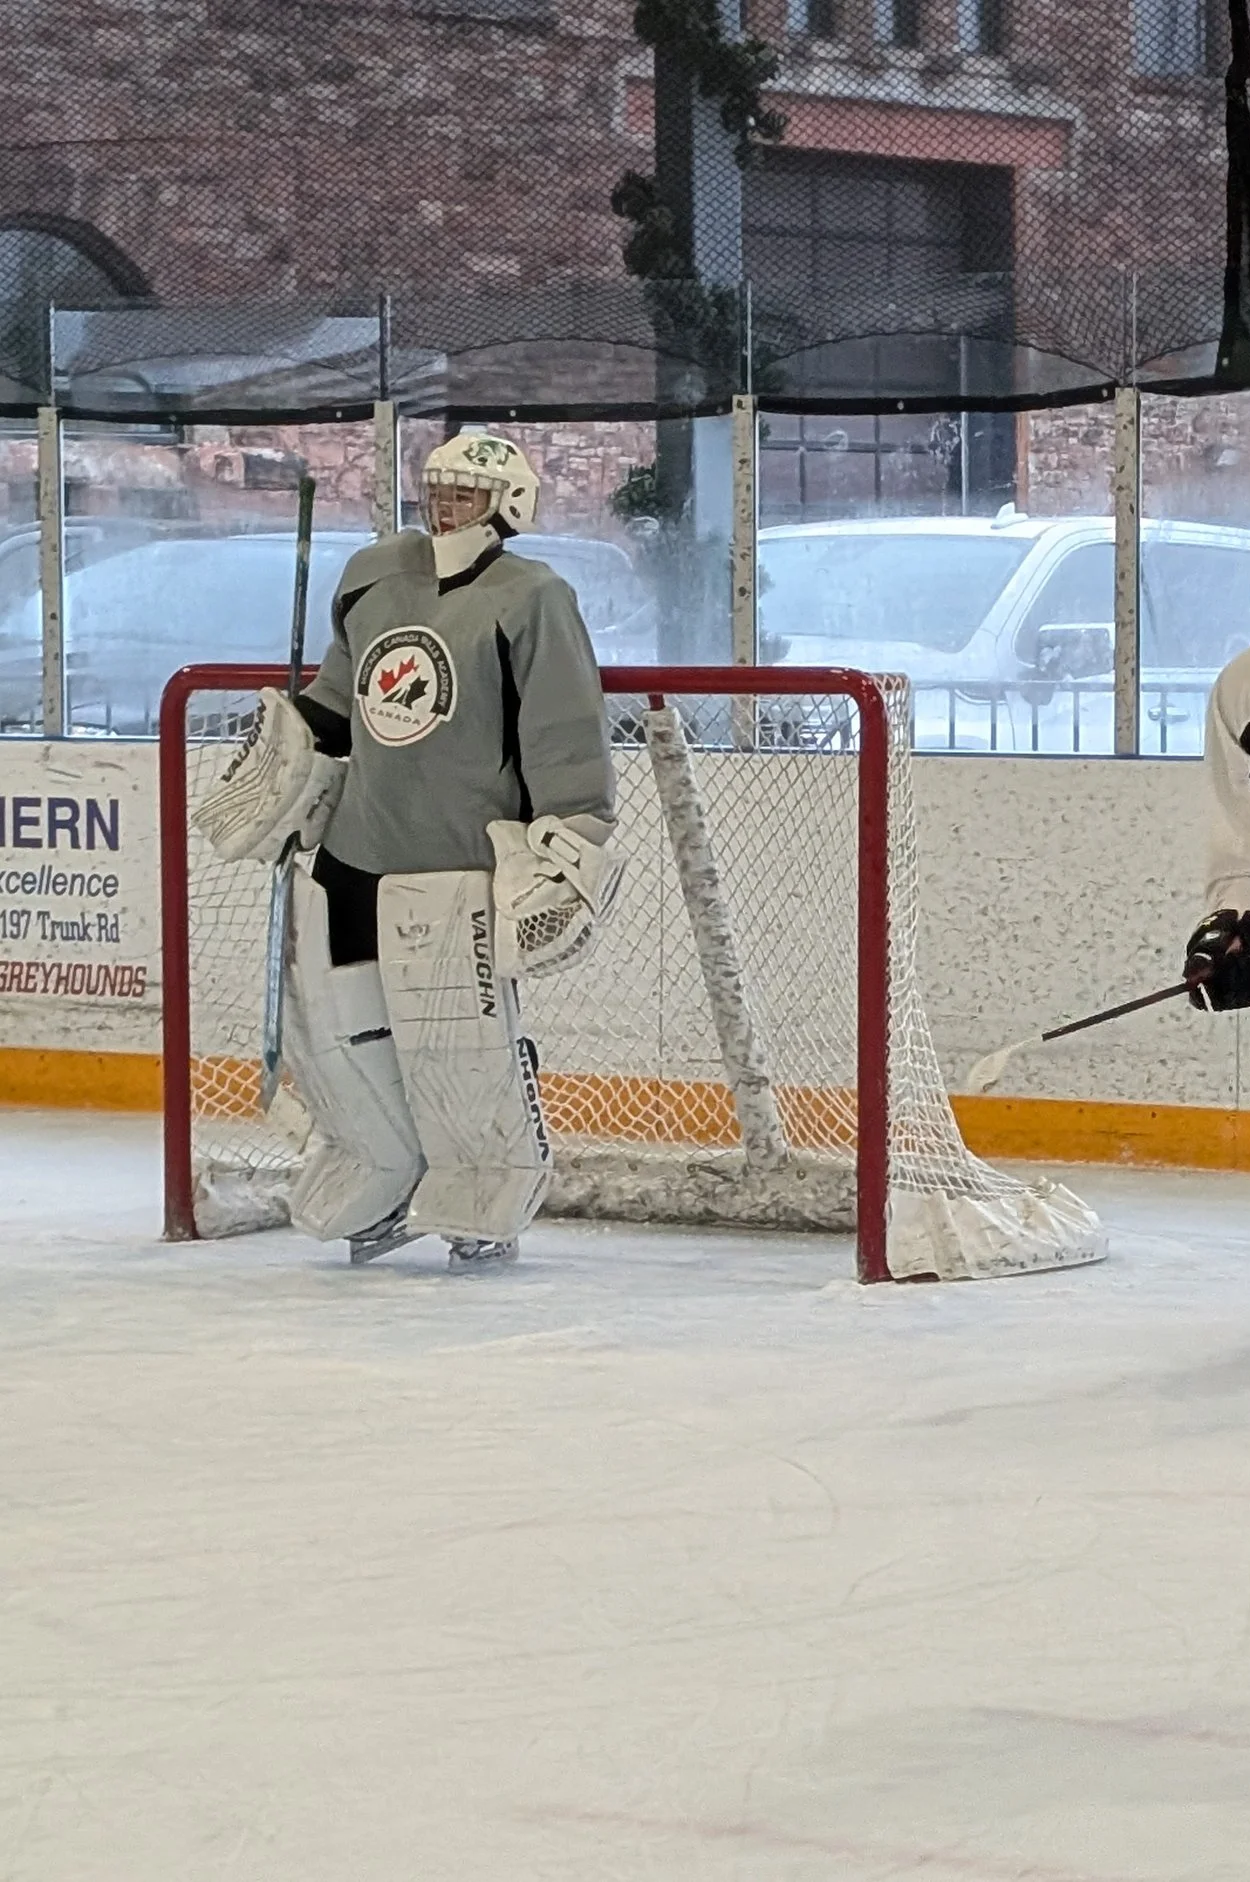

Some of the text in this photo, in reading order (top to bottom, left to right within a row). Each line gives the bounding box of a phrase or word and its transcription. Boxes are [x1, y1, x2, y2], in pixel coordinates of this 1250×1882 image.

[369, 707, 421, 726] CANADA
[36, 911, 93, 942] Trunk
[96, 912, 120, 943] Rd
[0, 960, 147, 998] GREYHOUNDS
[470, 908, 498, 1019] VAUGHN
[515, 1036, 549, 1162] VAUGHN
